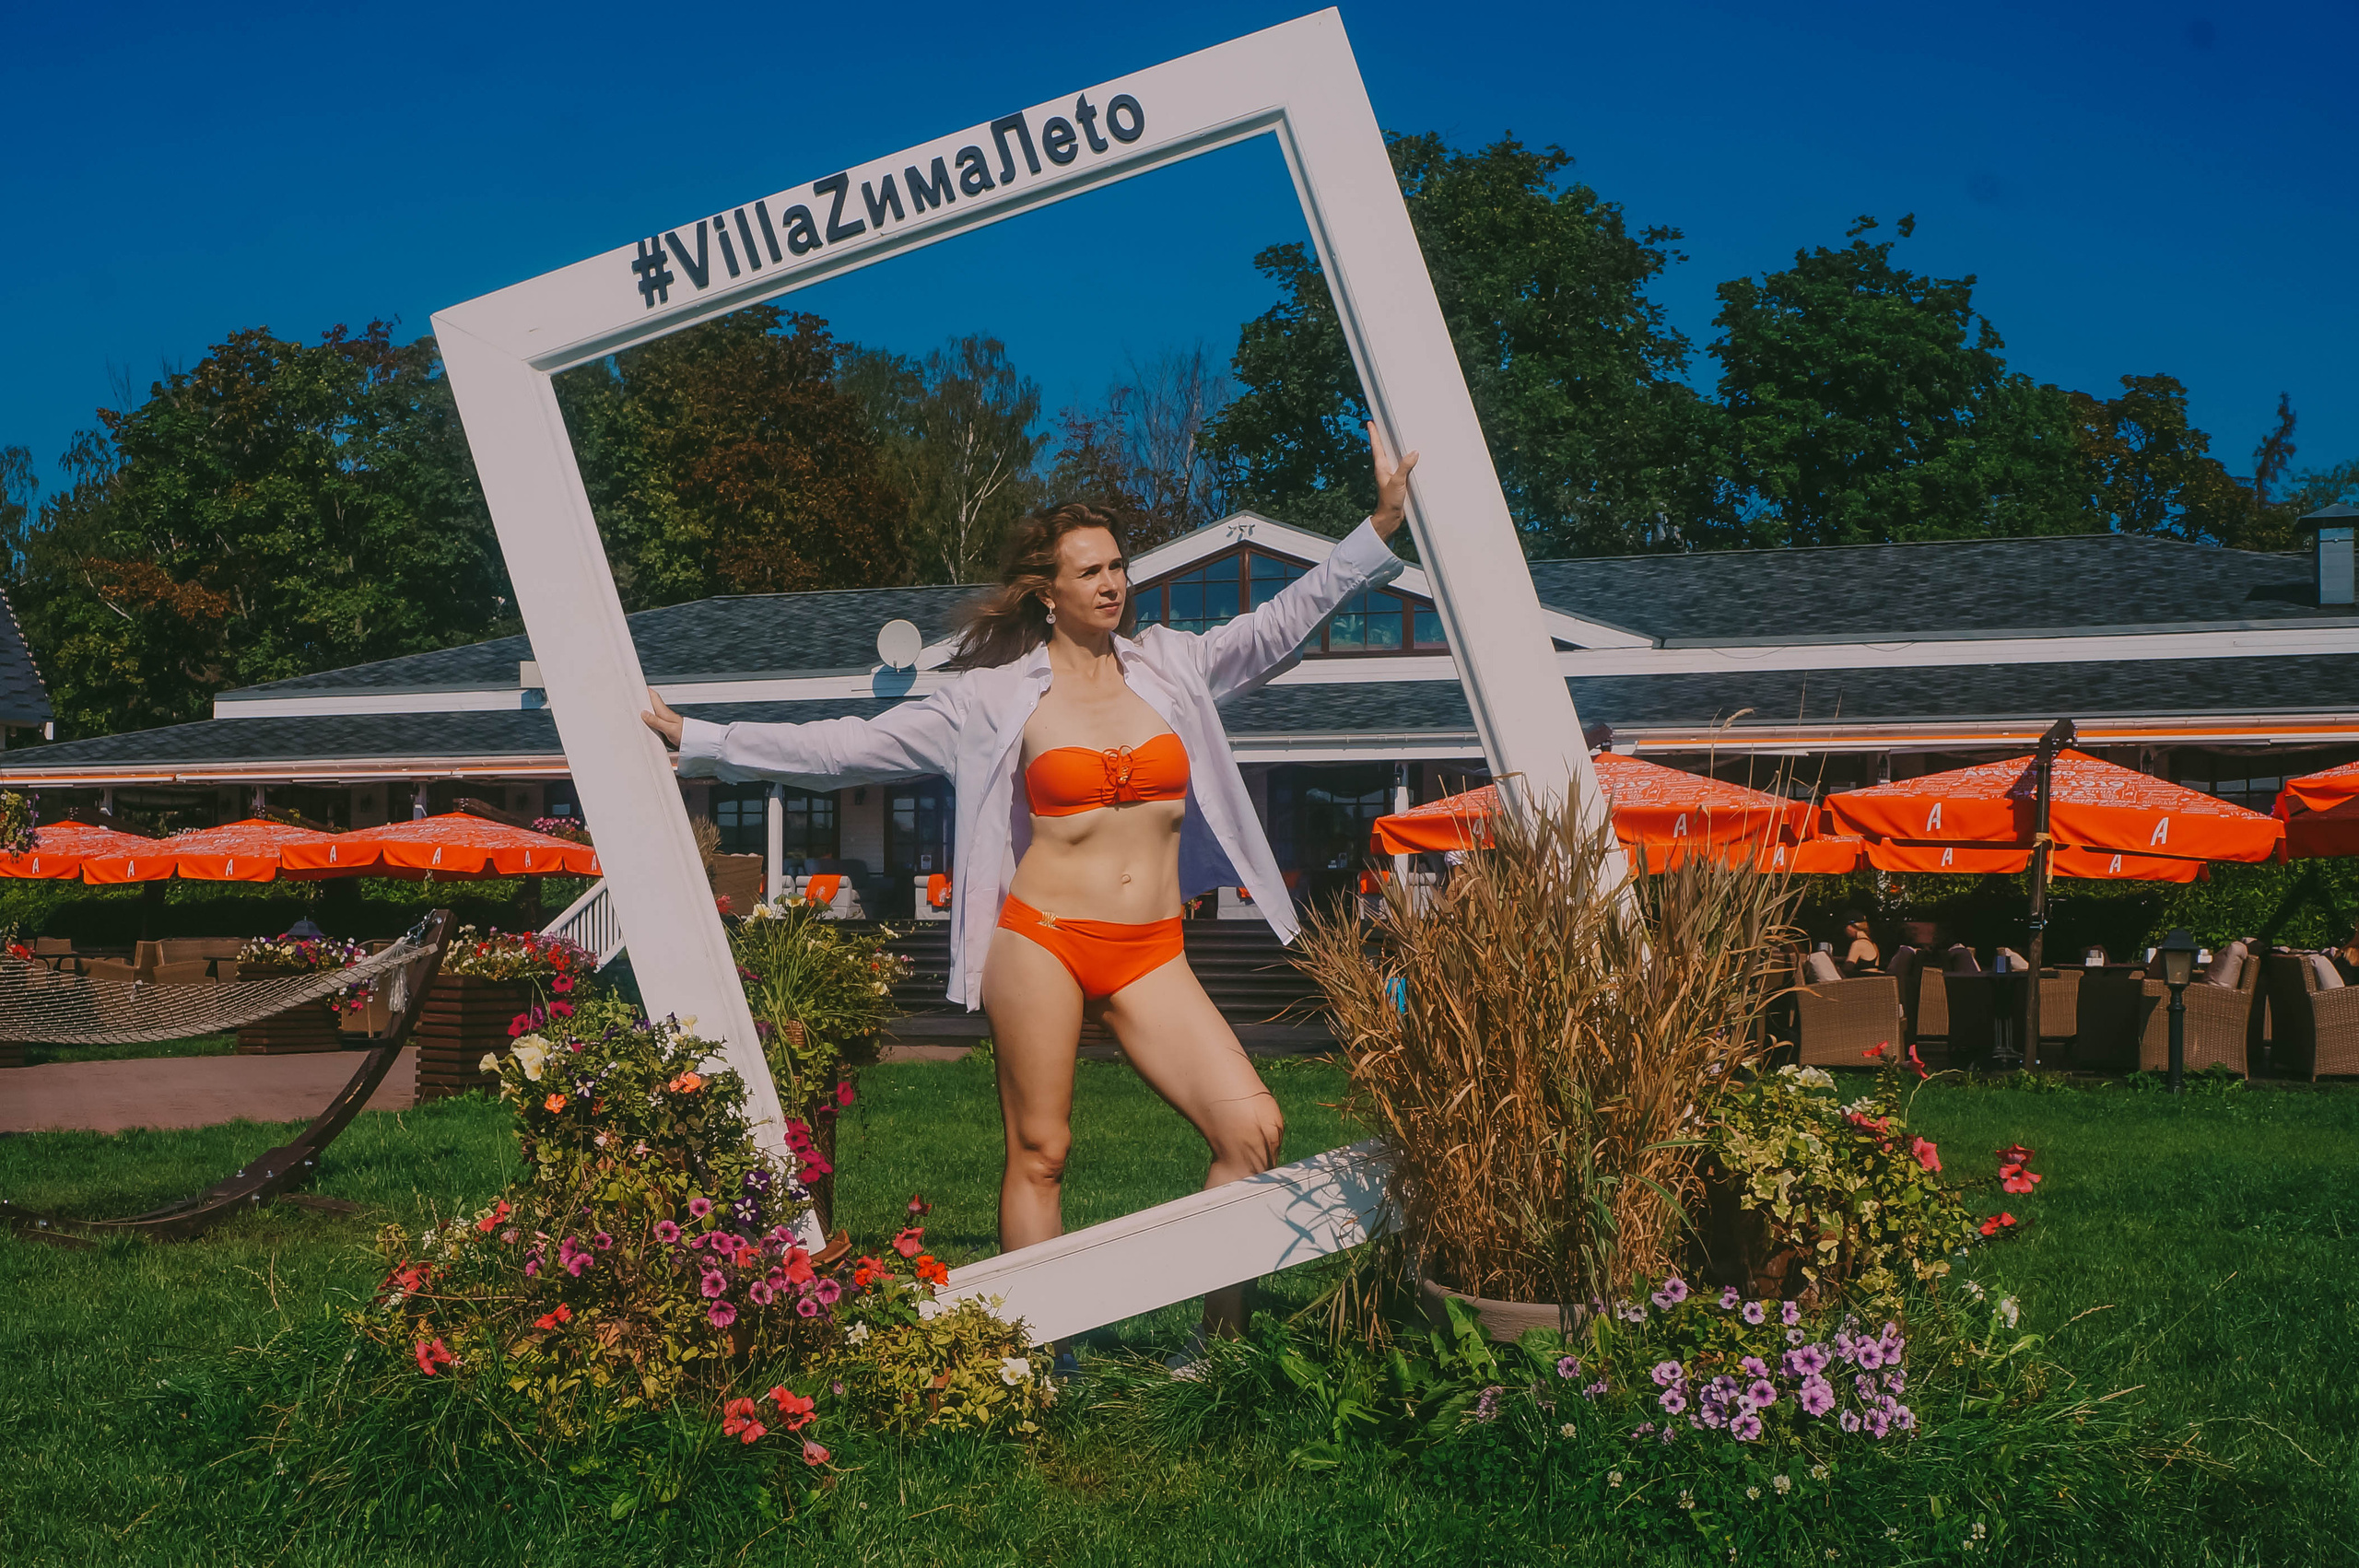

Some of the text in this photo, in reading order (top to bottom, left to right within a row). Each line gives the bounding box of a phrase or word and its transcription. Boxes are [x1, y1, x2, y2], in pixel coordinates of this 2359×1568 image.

[1672, 813, 1687, 838] A
[1926, 802, 1942, 831] A
[2150, 816, 2169, 847] A
[329, 845, 337, 863] A
[431, 847, 441, 865] A
[524, 850, 532, 868] A
[1770, 846, 1785, 867] A
[1941, 847, 1954, 867] A
[31, 857, 40, 874] A
[127, 860, 135, 878] A
[225, 859, 234, 876] A
[2108, 854, 2122, 874] A
